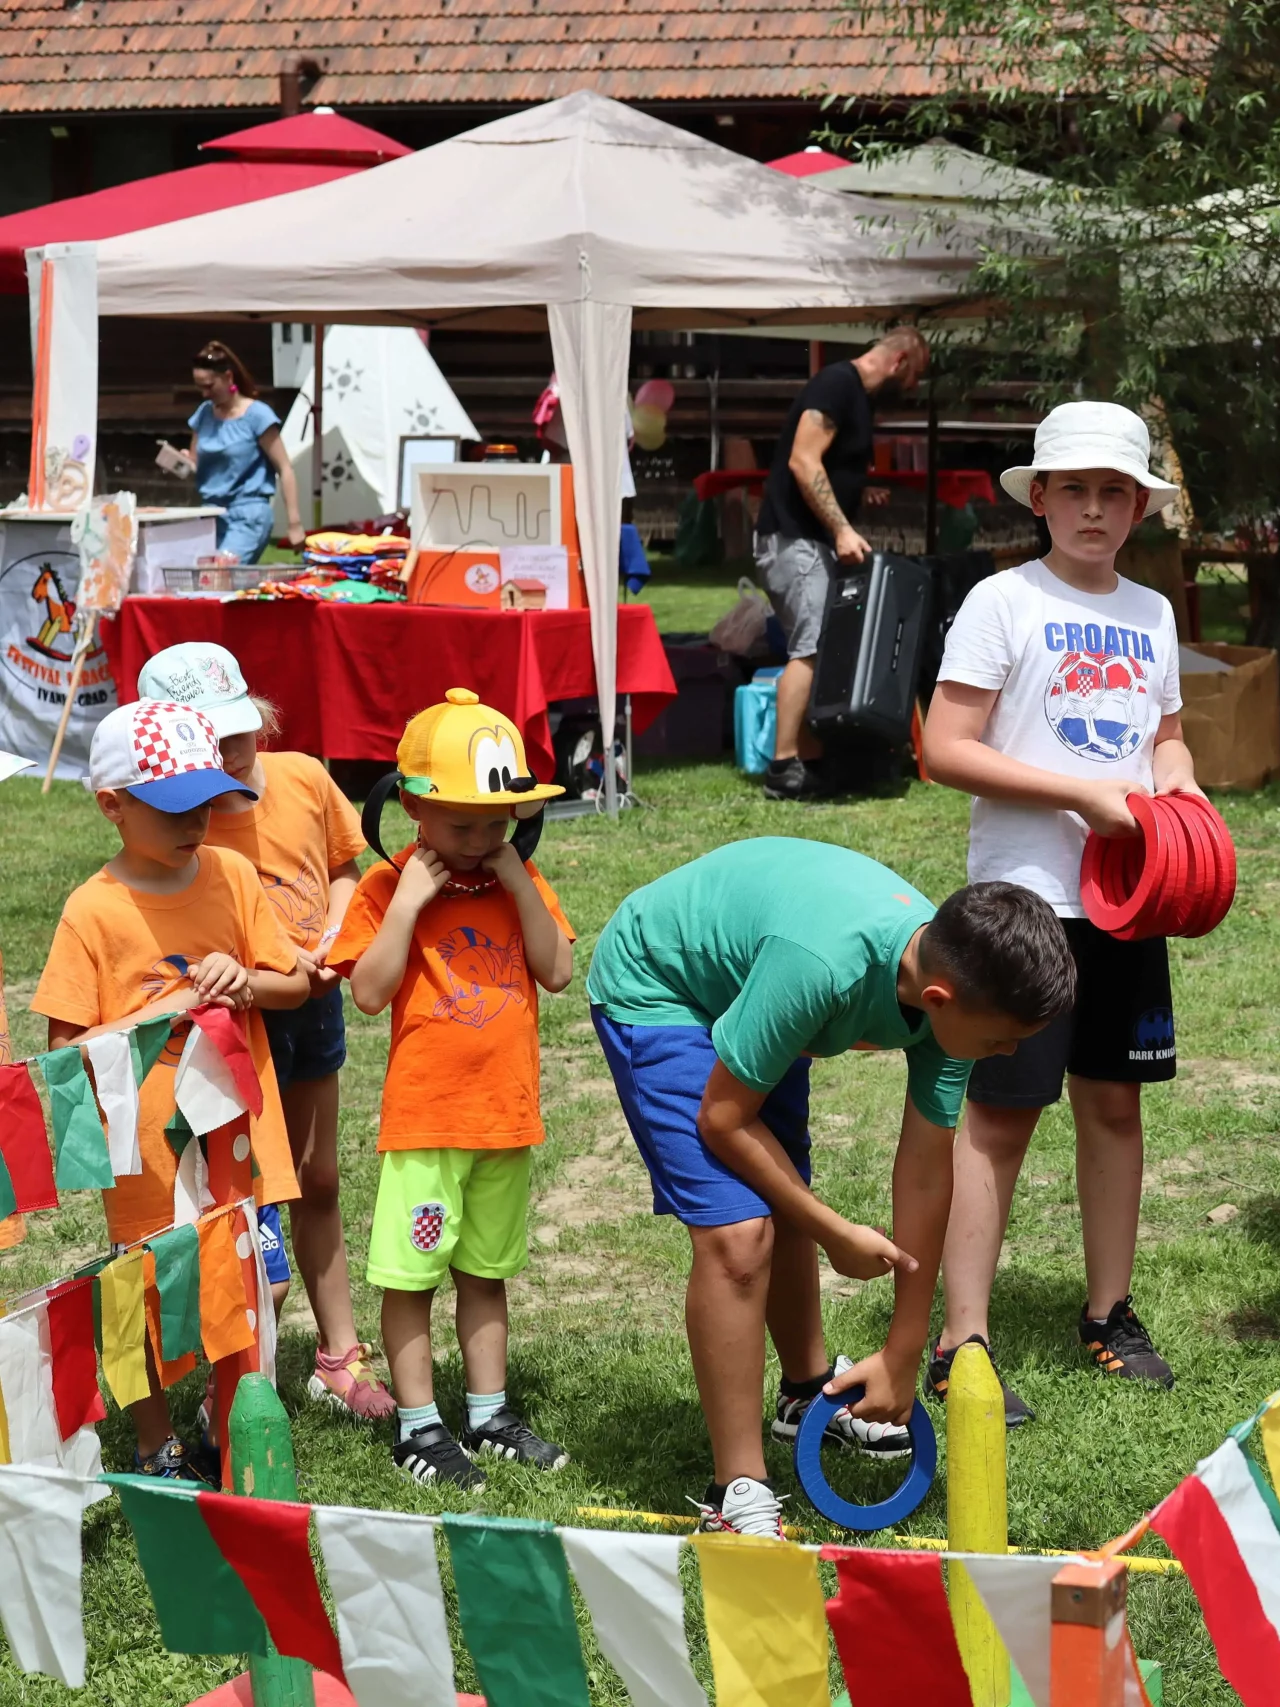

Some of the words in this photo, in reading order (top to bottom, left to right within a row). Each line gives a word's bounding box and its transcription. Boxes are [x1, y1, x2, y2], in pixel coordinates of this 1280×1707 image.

[1044, 622, 1156, 664] CROATIA
[1128, 1050, 1155, 1061] DARK
[1156, 1045, 1176, 1060] KNIG
